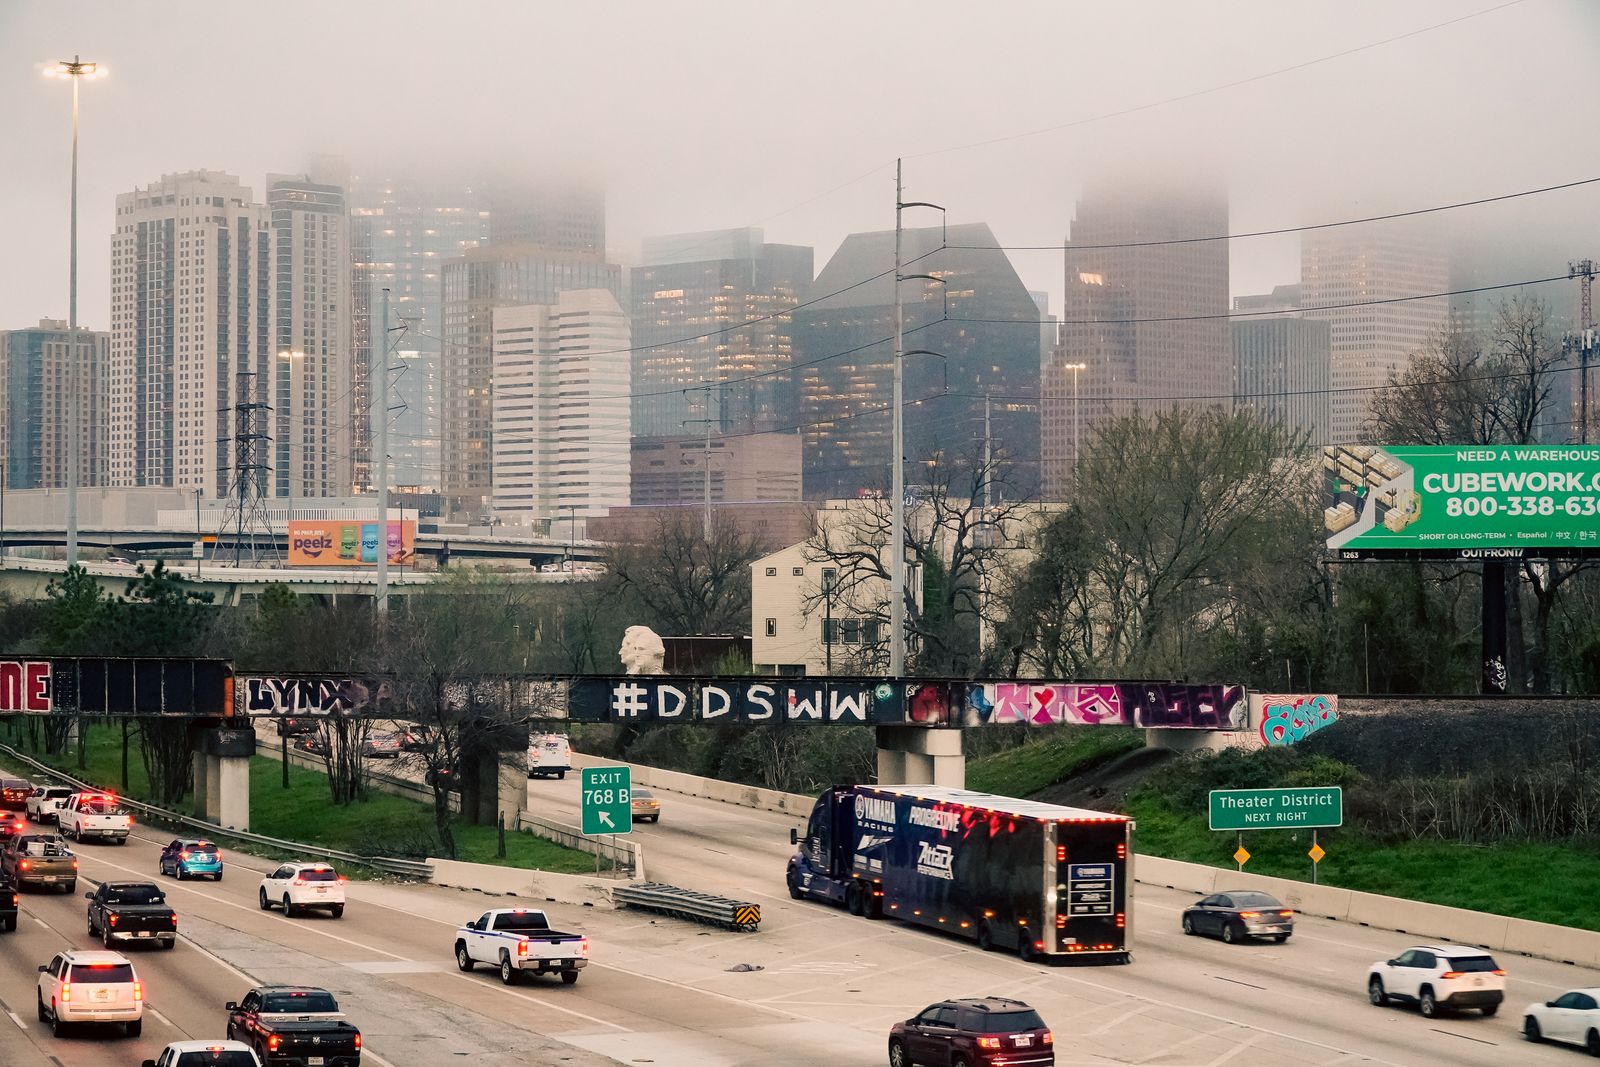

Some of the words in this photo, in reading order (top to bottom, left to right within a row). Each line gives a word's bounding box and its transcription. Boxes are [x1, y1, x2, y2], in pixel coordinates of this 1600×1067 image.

[1456, 451, 1497, 462] NEED
[1500, 450, 1511, 461] A
[1514, 450, 1600, 461] WAREHOUS
[1446, 496, 1600, 517] 800-338-63
[1461, 532, 1506, 540] LONG-TERM
[1517, 531, 1548, 540] Español
[1556, 531, 1571, 540] 中文
[294, 535, 332, 551] peelz
[1343, 551, 1359, 559] 1263
[246, 678, 353, 715] LYNX
[591, 773, 622, 785] EXIT
[584, 789, 614, 805] 768
[619, 788, 630, 804] B
[1219, 796, 1275, 809] Theater
[1281, 793, 1333, 807] District
[864, 797, 896, 824] YAMAHA
[1245, 813, 1272, 822] NEXT
[1276, 811, 1308, 822] RIGHT
[857, 820, 895, 833] RACING
